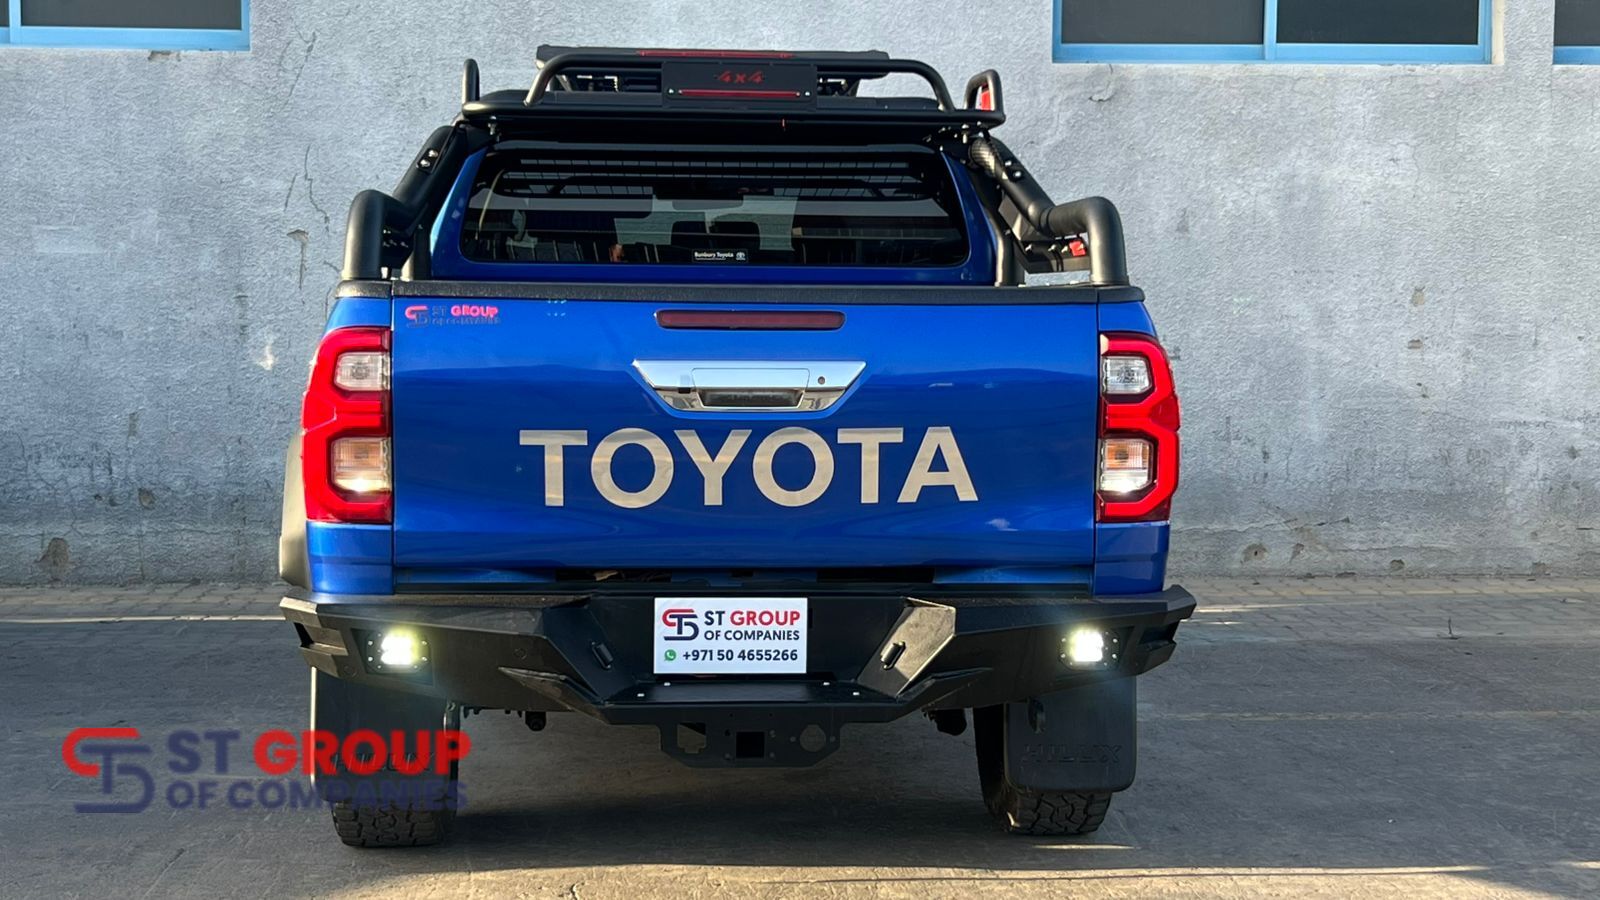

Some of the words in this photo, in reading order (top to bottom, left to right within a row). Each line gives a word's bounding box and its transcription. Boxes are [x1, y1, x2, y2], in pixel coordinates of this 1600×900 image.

[450, 304, 499, 318] GROUP
[519, 426, 979, 508] TOYOTA
[704, 610, 726, 626] ST
[729, 610, 801, 626] GROUP
[704, 630, 721, 641] OF
[724, 630, 800, 641] COMPANIES
[682, 649, 713, 661] +971
[716, 649, 734, 661] 50
[737, 649, 798, 661] 4655266
